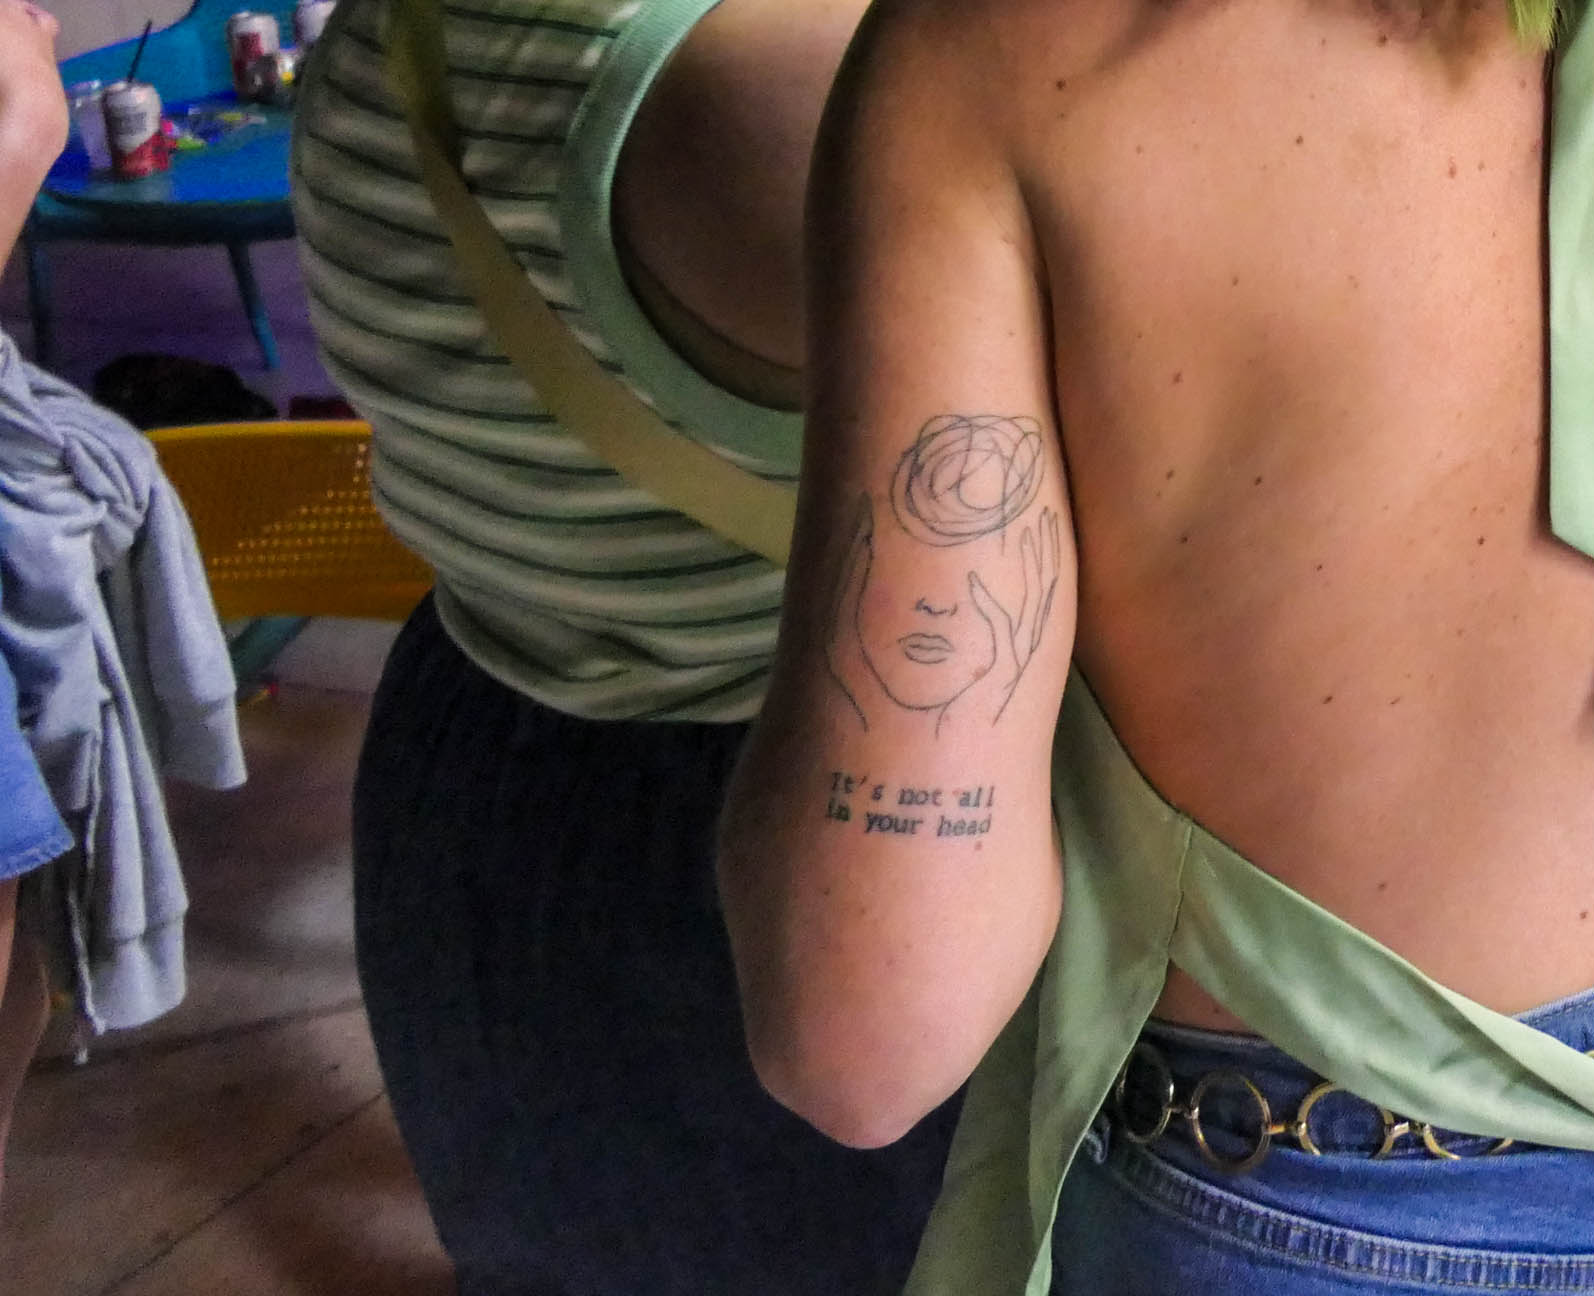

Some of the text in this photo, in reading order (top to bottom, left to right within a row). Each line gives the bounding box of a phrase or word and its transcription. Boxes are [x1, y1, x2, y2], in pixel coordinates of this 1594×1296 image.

[831, 771, 996, 808] It's not all
[827, 798, 993, 837] in your head
